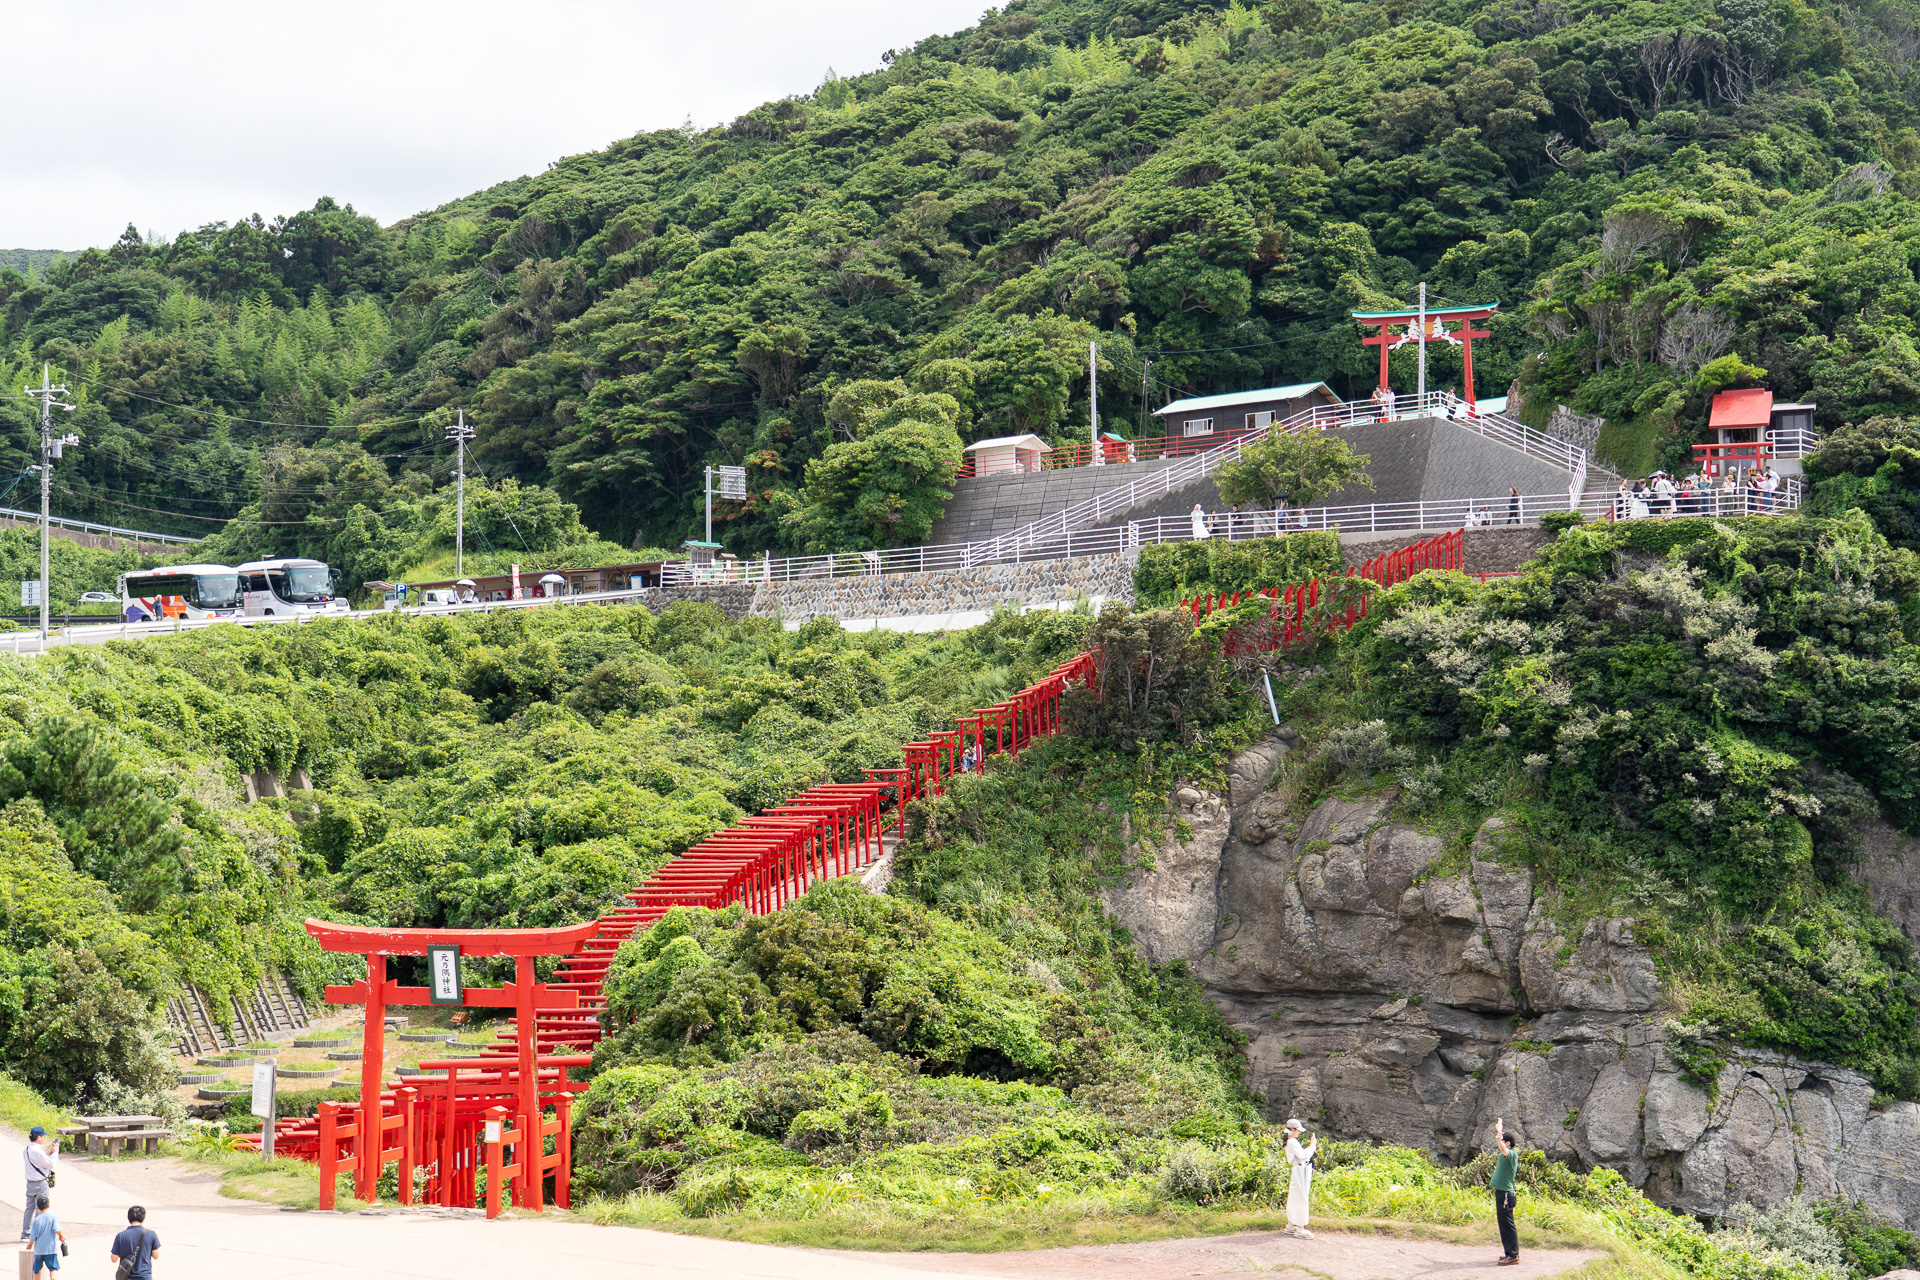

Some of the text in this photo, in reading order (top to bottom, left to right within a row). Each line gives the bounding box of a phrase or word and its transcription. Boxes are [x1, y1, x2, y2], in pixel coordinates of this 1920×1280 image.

[441, 953, 452, 994] 元乃隅神社
